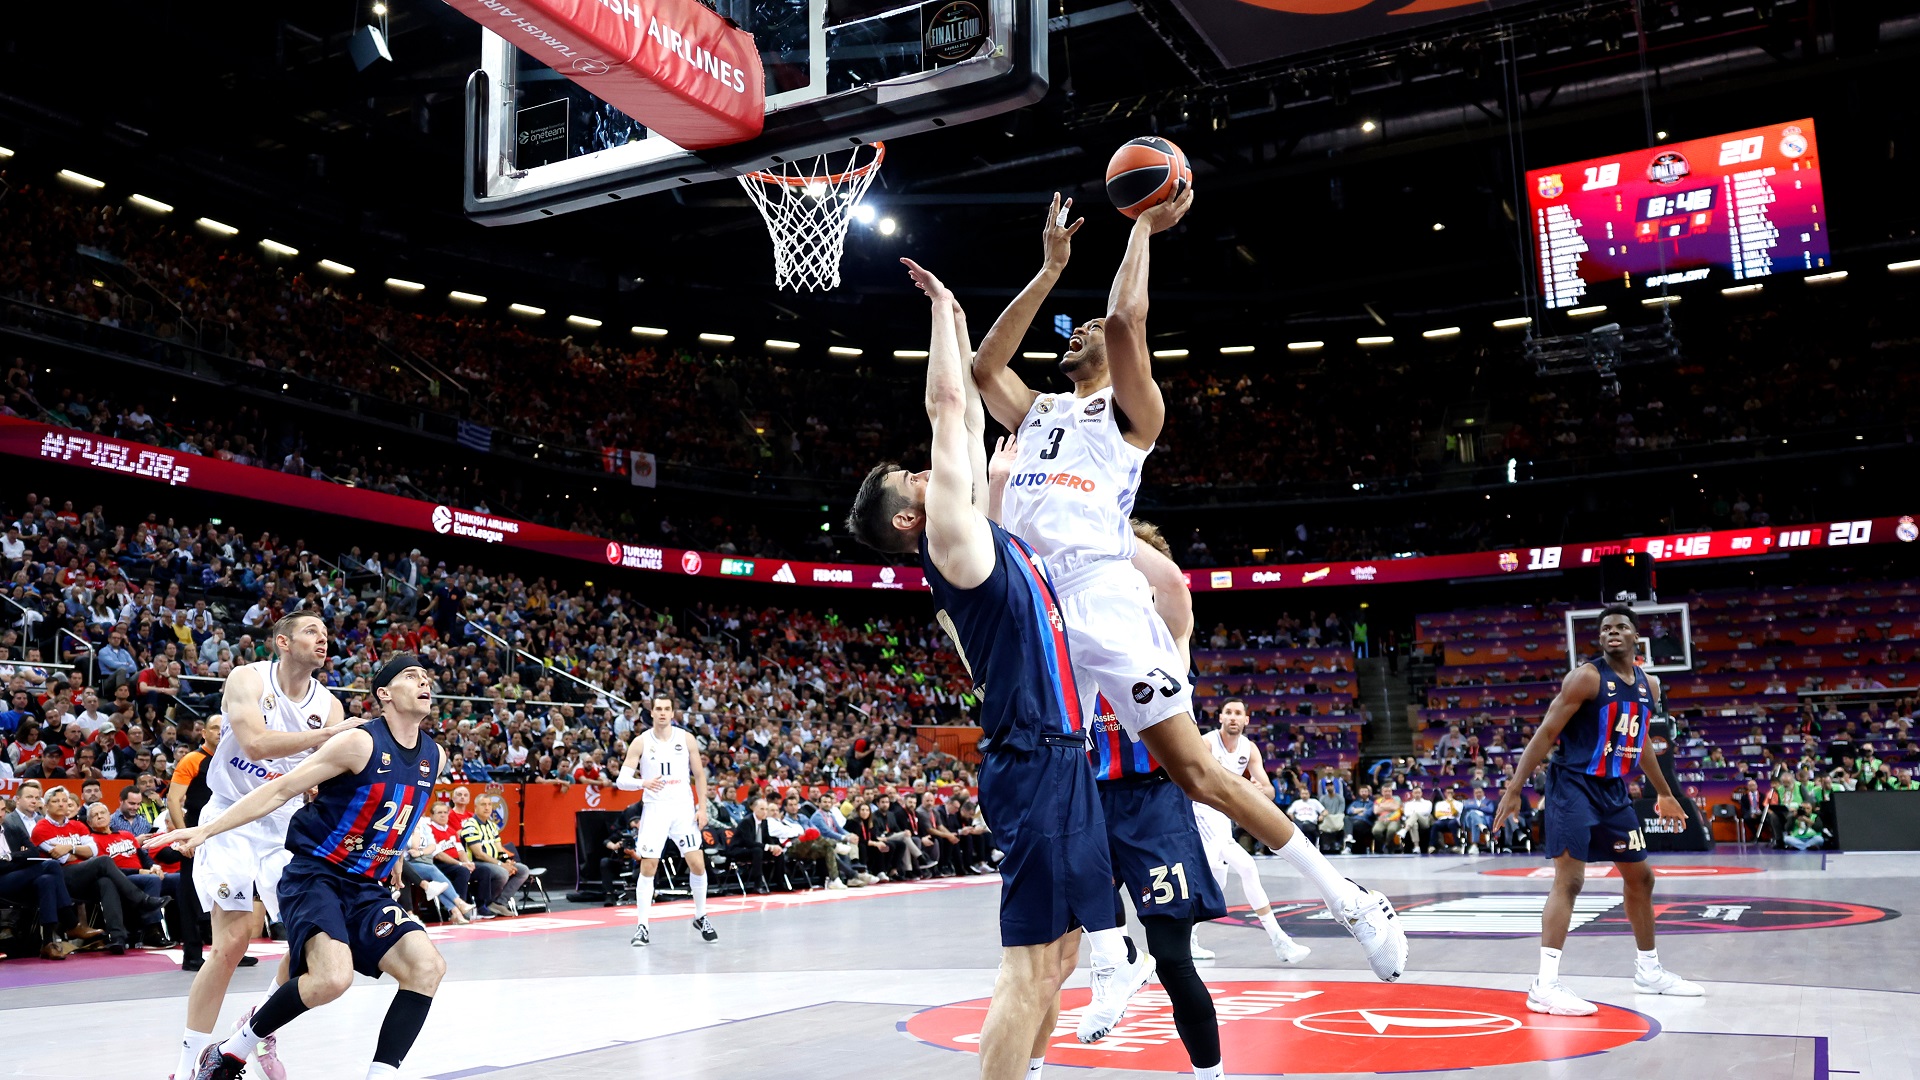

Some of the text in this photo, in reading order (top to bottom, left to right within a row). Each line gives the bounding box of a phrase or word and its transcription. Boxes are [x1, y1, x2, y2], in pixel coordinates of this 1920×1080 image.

[478, 0, 577, 58] TURKISH AIR
[931, 17, 980, 46] FINAL FOUR
[648, 15, 745, 94] AIRLINES
[530, 126, 565, 142] oneteam
[1718, 135, 1765, 166] 20
[1581, 163, 1621, 192] 18
[1646, 188, 1712, 219] 8:46
[1039, 427, 1066, 460] 3
[1010, 472, 1096, 493] AUTOHERO
[453, 521, 504, 543] EuroLeague
[454, 511, 519, 534] TURKISH AIRLINES
[1828, 520, 1873, 546] 20
[621, 555, 663, 570] AIRLINES
[622, 544, 662, 560] TURKISH
[1527, 546, 1563, 571] 18
[1146, 667, 1182, 698] 3
[1093, 712, 1118, 723] Assist
[1615, 713, 1640, 738] 46
[229, 756, 284, 781] AUTOHE
[660, 762, 671, 776] 11
[372, 801, 414, 836] 24
[685, 834, 697, 848] 11
[1149, 862, 1190, 905] 31
[382, 905, 412, 926] 2
